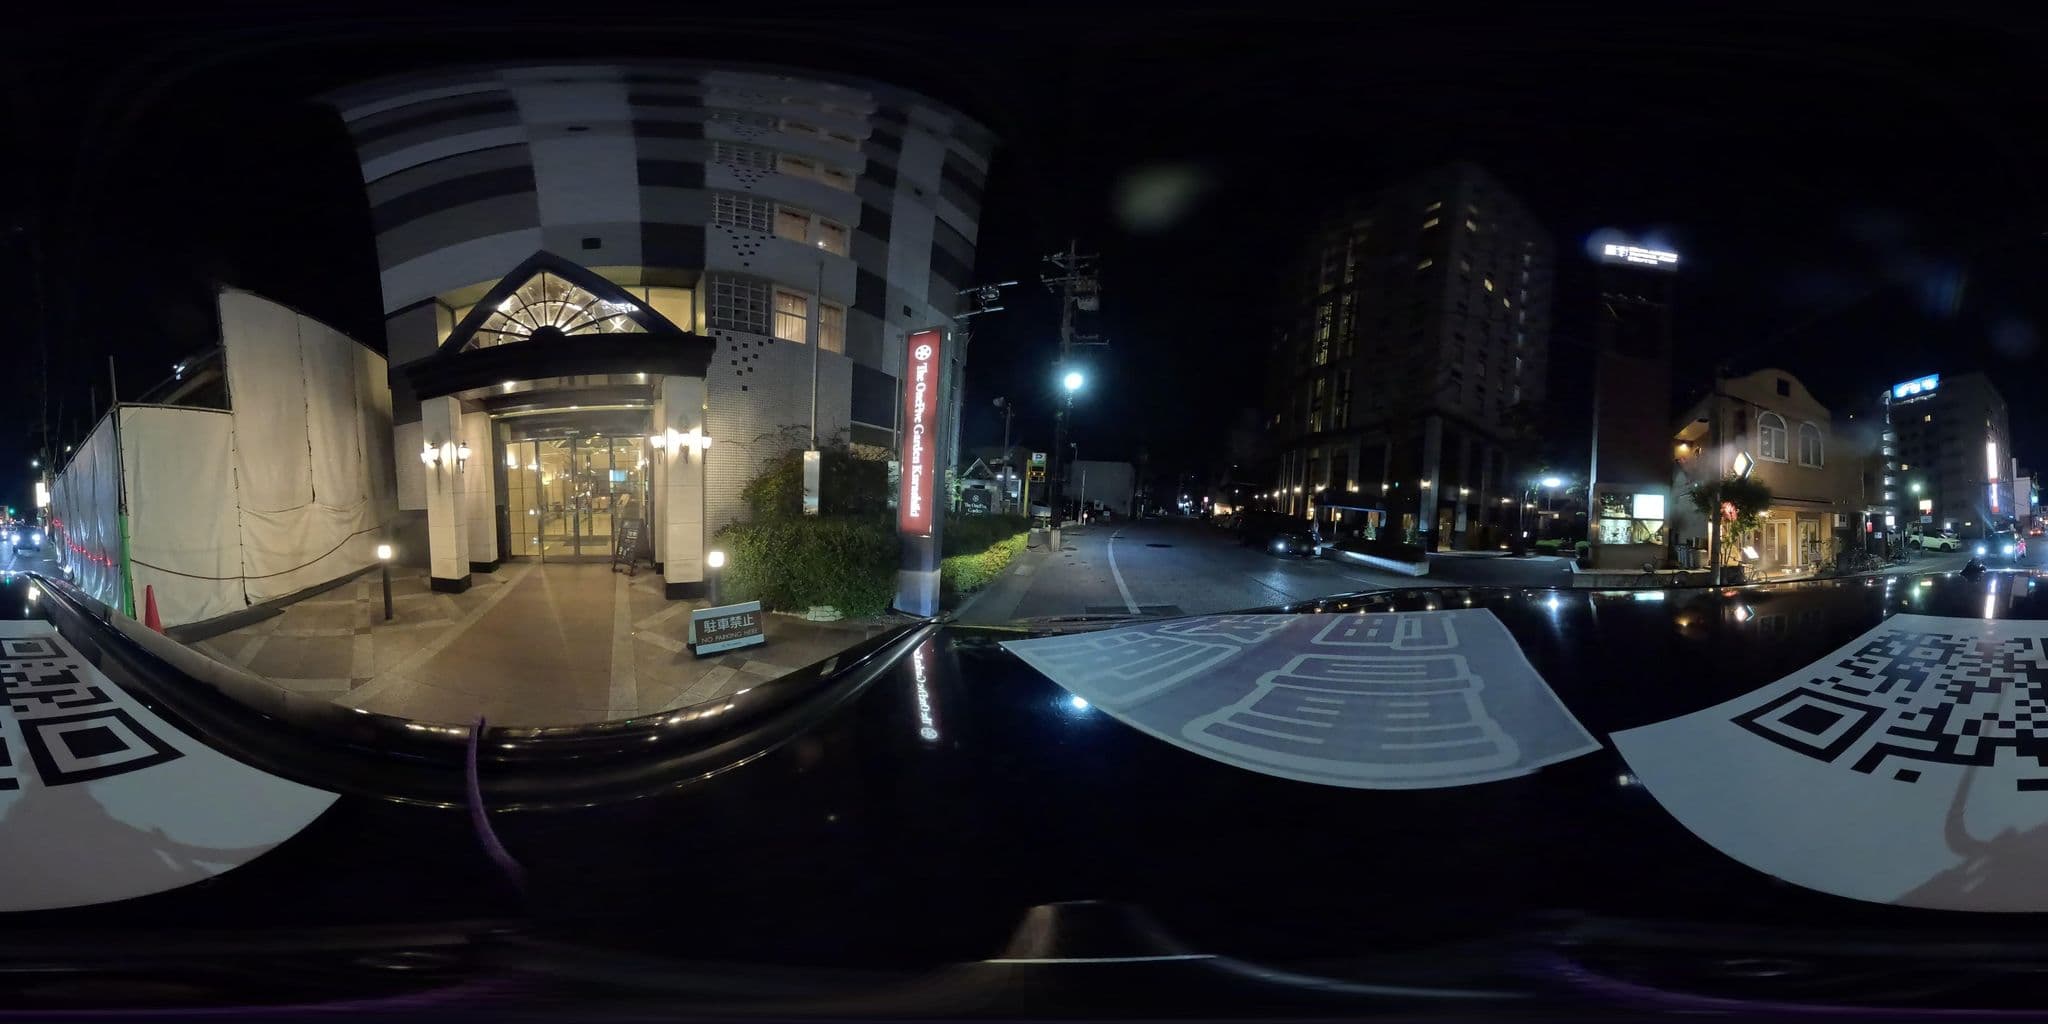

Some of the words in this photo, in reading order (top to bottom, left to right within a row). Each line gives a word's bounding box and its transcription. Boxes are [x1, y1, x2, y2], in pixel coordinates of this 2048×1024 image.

[916, 362, 928, 382] The
[912, 424, 924, 464] Garden
[703, 614, 754, 633] 駐車禁止
[715, 631, 742, 641] PARKING
